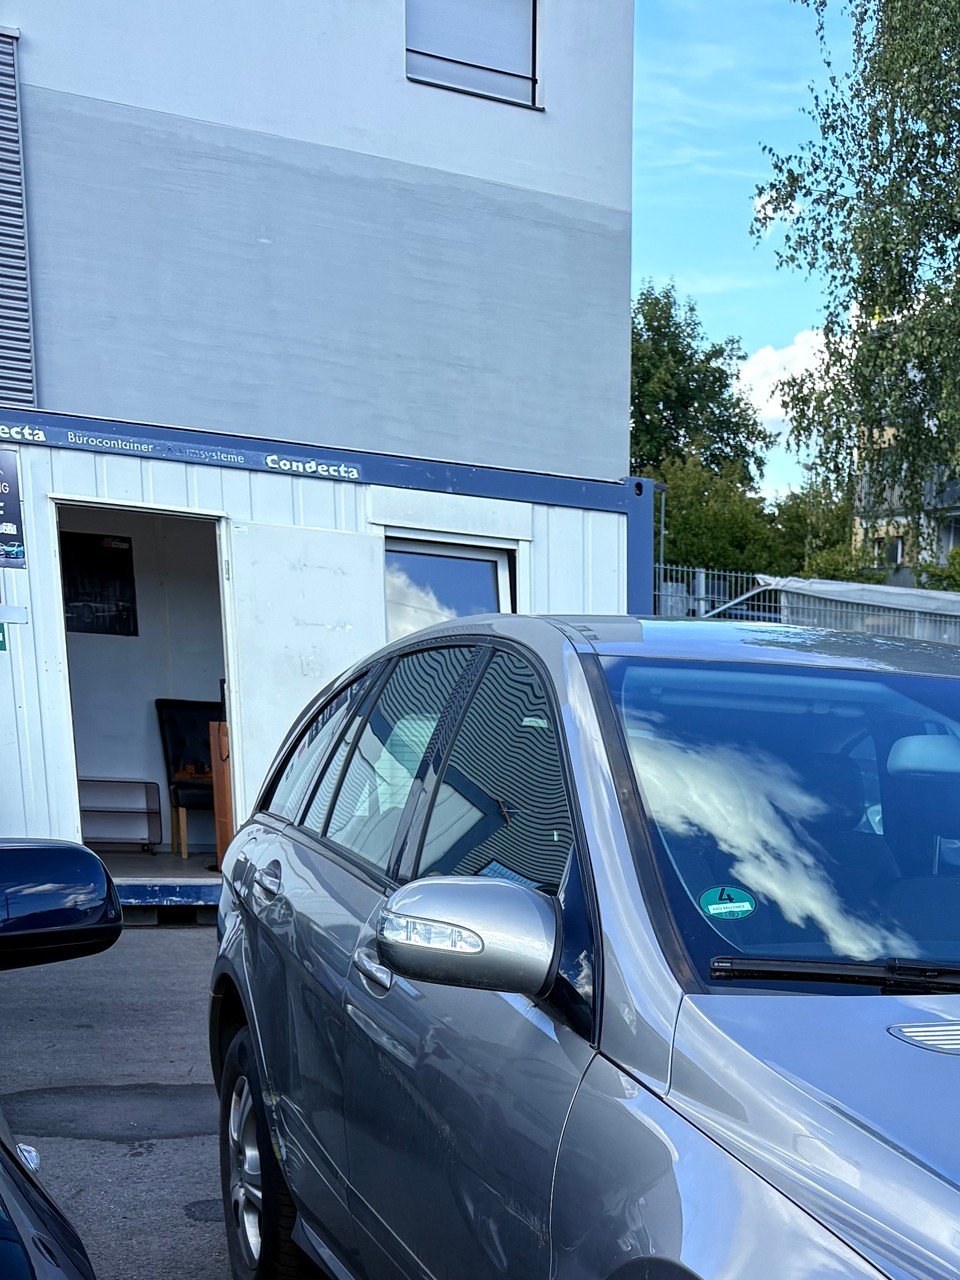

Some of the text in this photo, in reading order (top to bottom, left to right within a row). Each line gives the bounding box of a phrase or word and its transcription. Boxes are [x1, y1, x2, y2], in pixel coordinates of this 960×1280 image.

[67, 431, 154, 452] Bürocontainer
[265, 454, 359, 479] Condecta
[718, 888, 734, 902] 4
